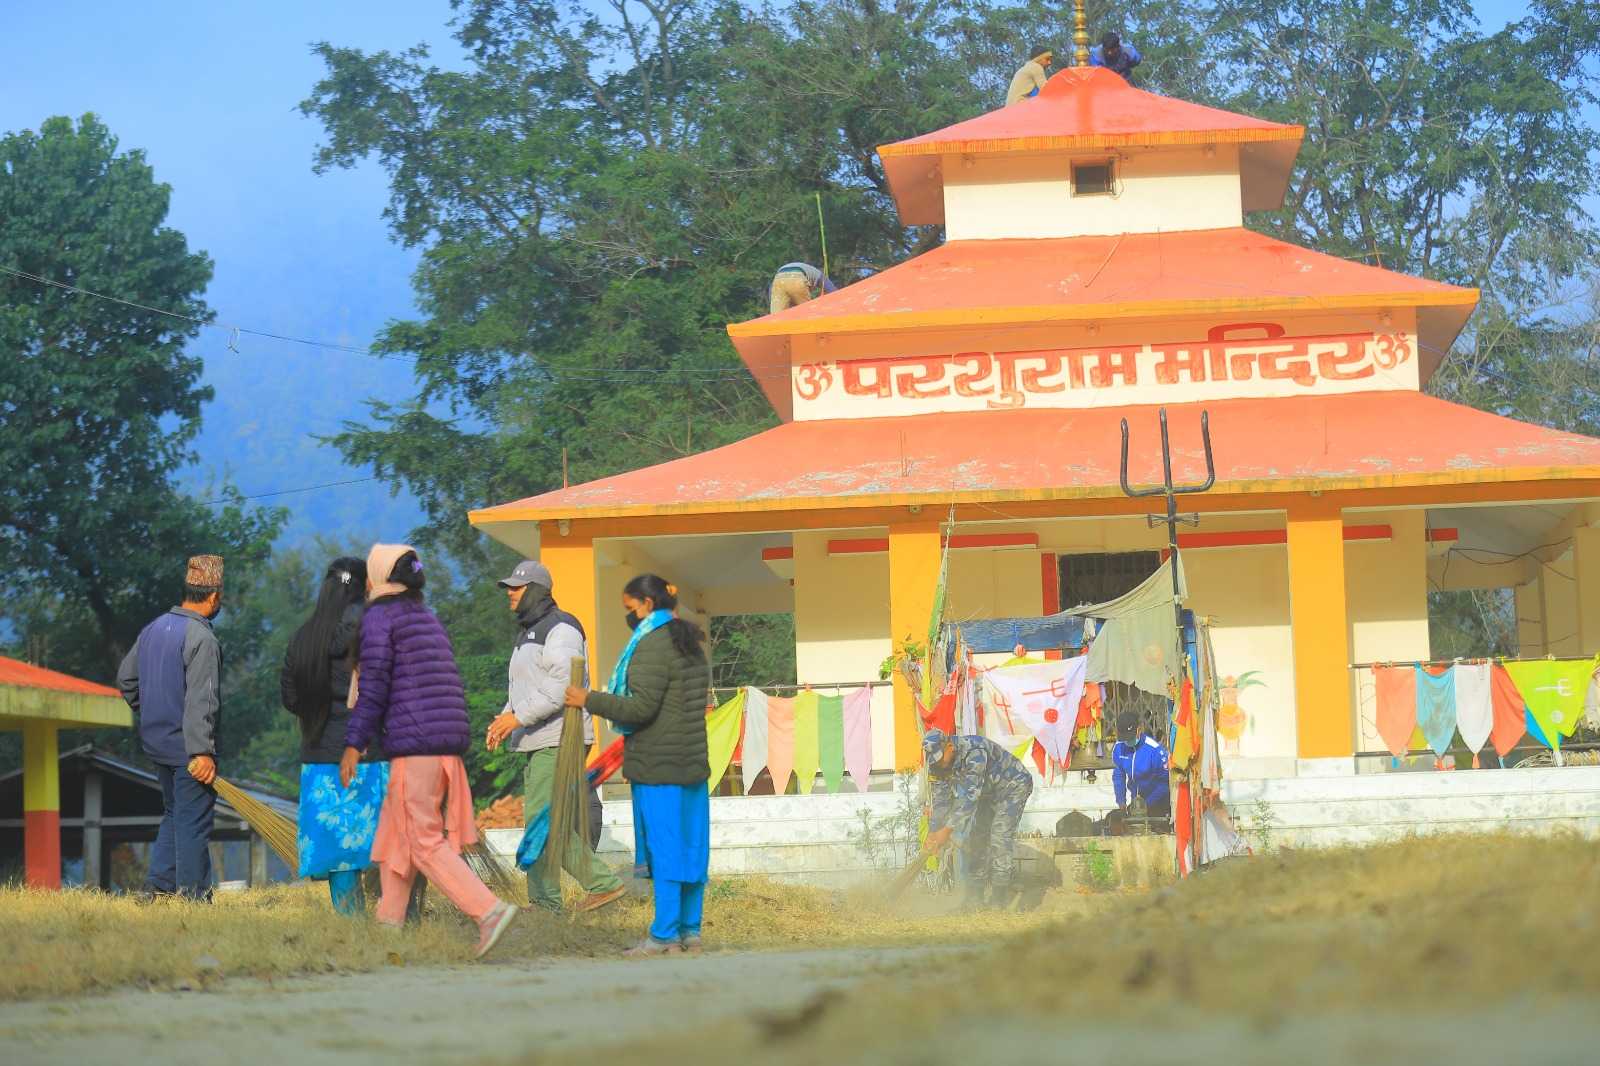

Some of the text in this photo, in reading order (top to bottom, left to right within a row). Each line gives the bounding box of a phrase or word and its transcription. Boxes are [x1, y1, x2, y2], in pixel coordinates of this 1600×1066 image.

[794, 361, 834, 400] ॐ
[836, 345, 1143, 408] परशुराम
[1374, 331, 1412, 370] ॐ
